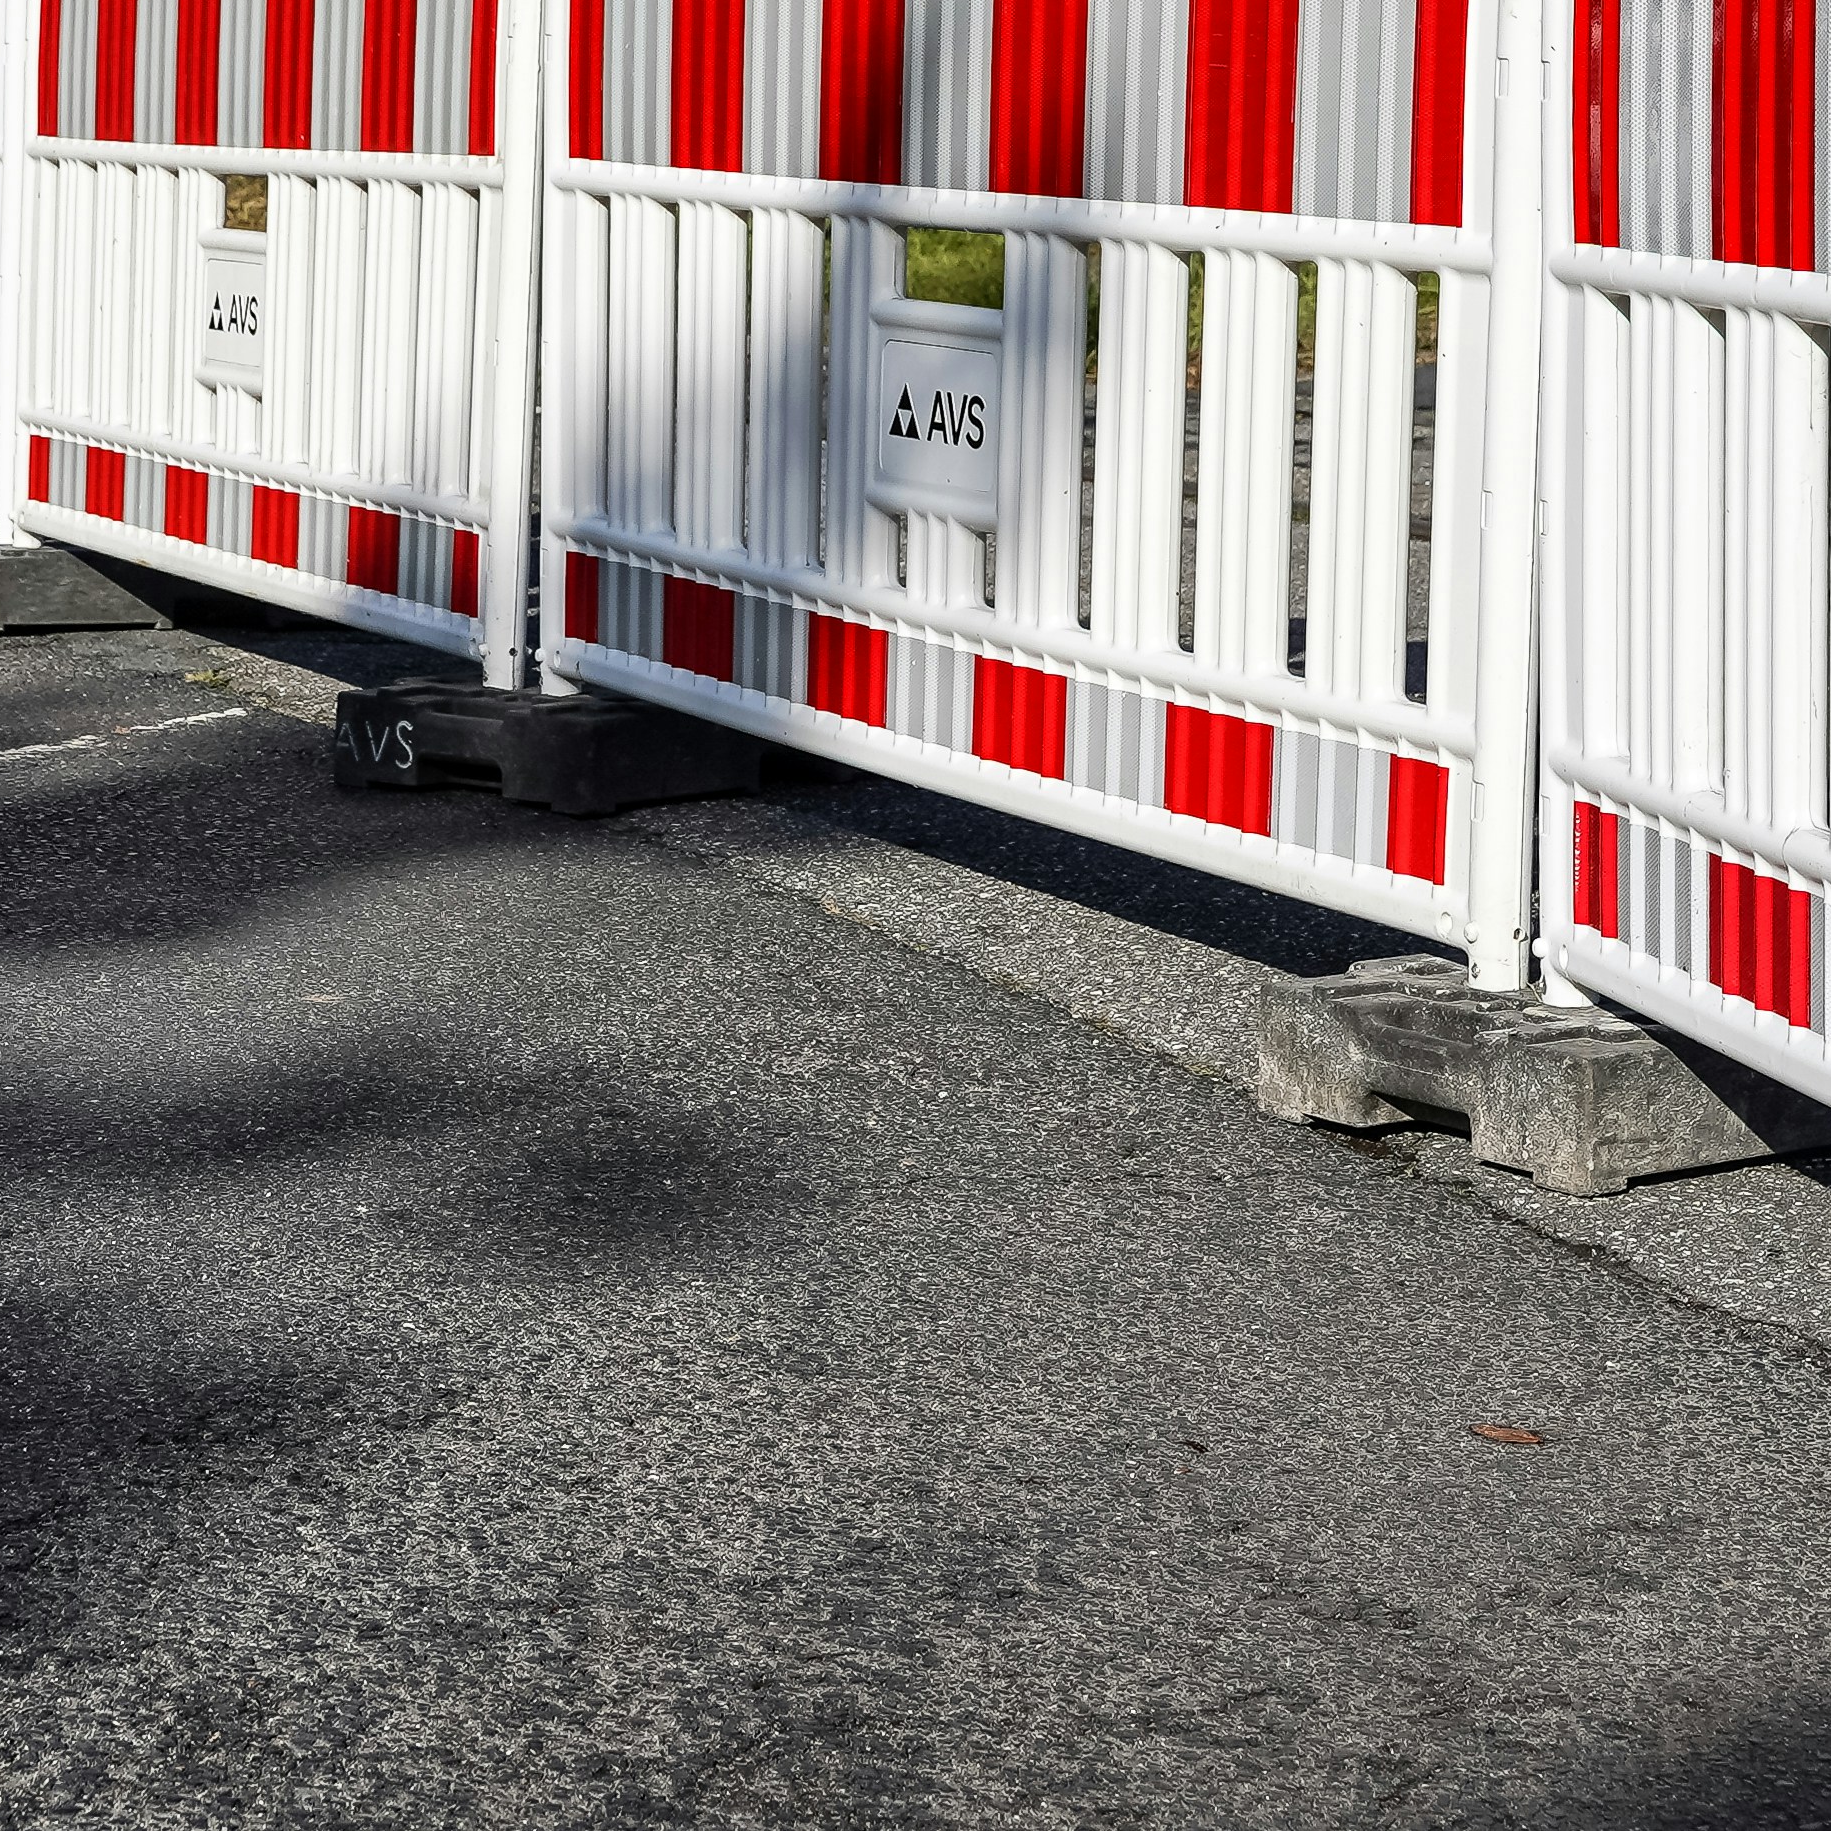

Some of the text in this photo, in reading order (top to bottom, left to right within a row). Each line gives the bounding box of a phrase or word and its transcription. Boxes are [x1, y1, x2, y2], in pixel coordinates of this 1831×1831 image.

[227, 293, 258, 336] AVS
[927, 390, 986, 450] AVS
[336, 720, 413, 769] AVS
